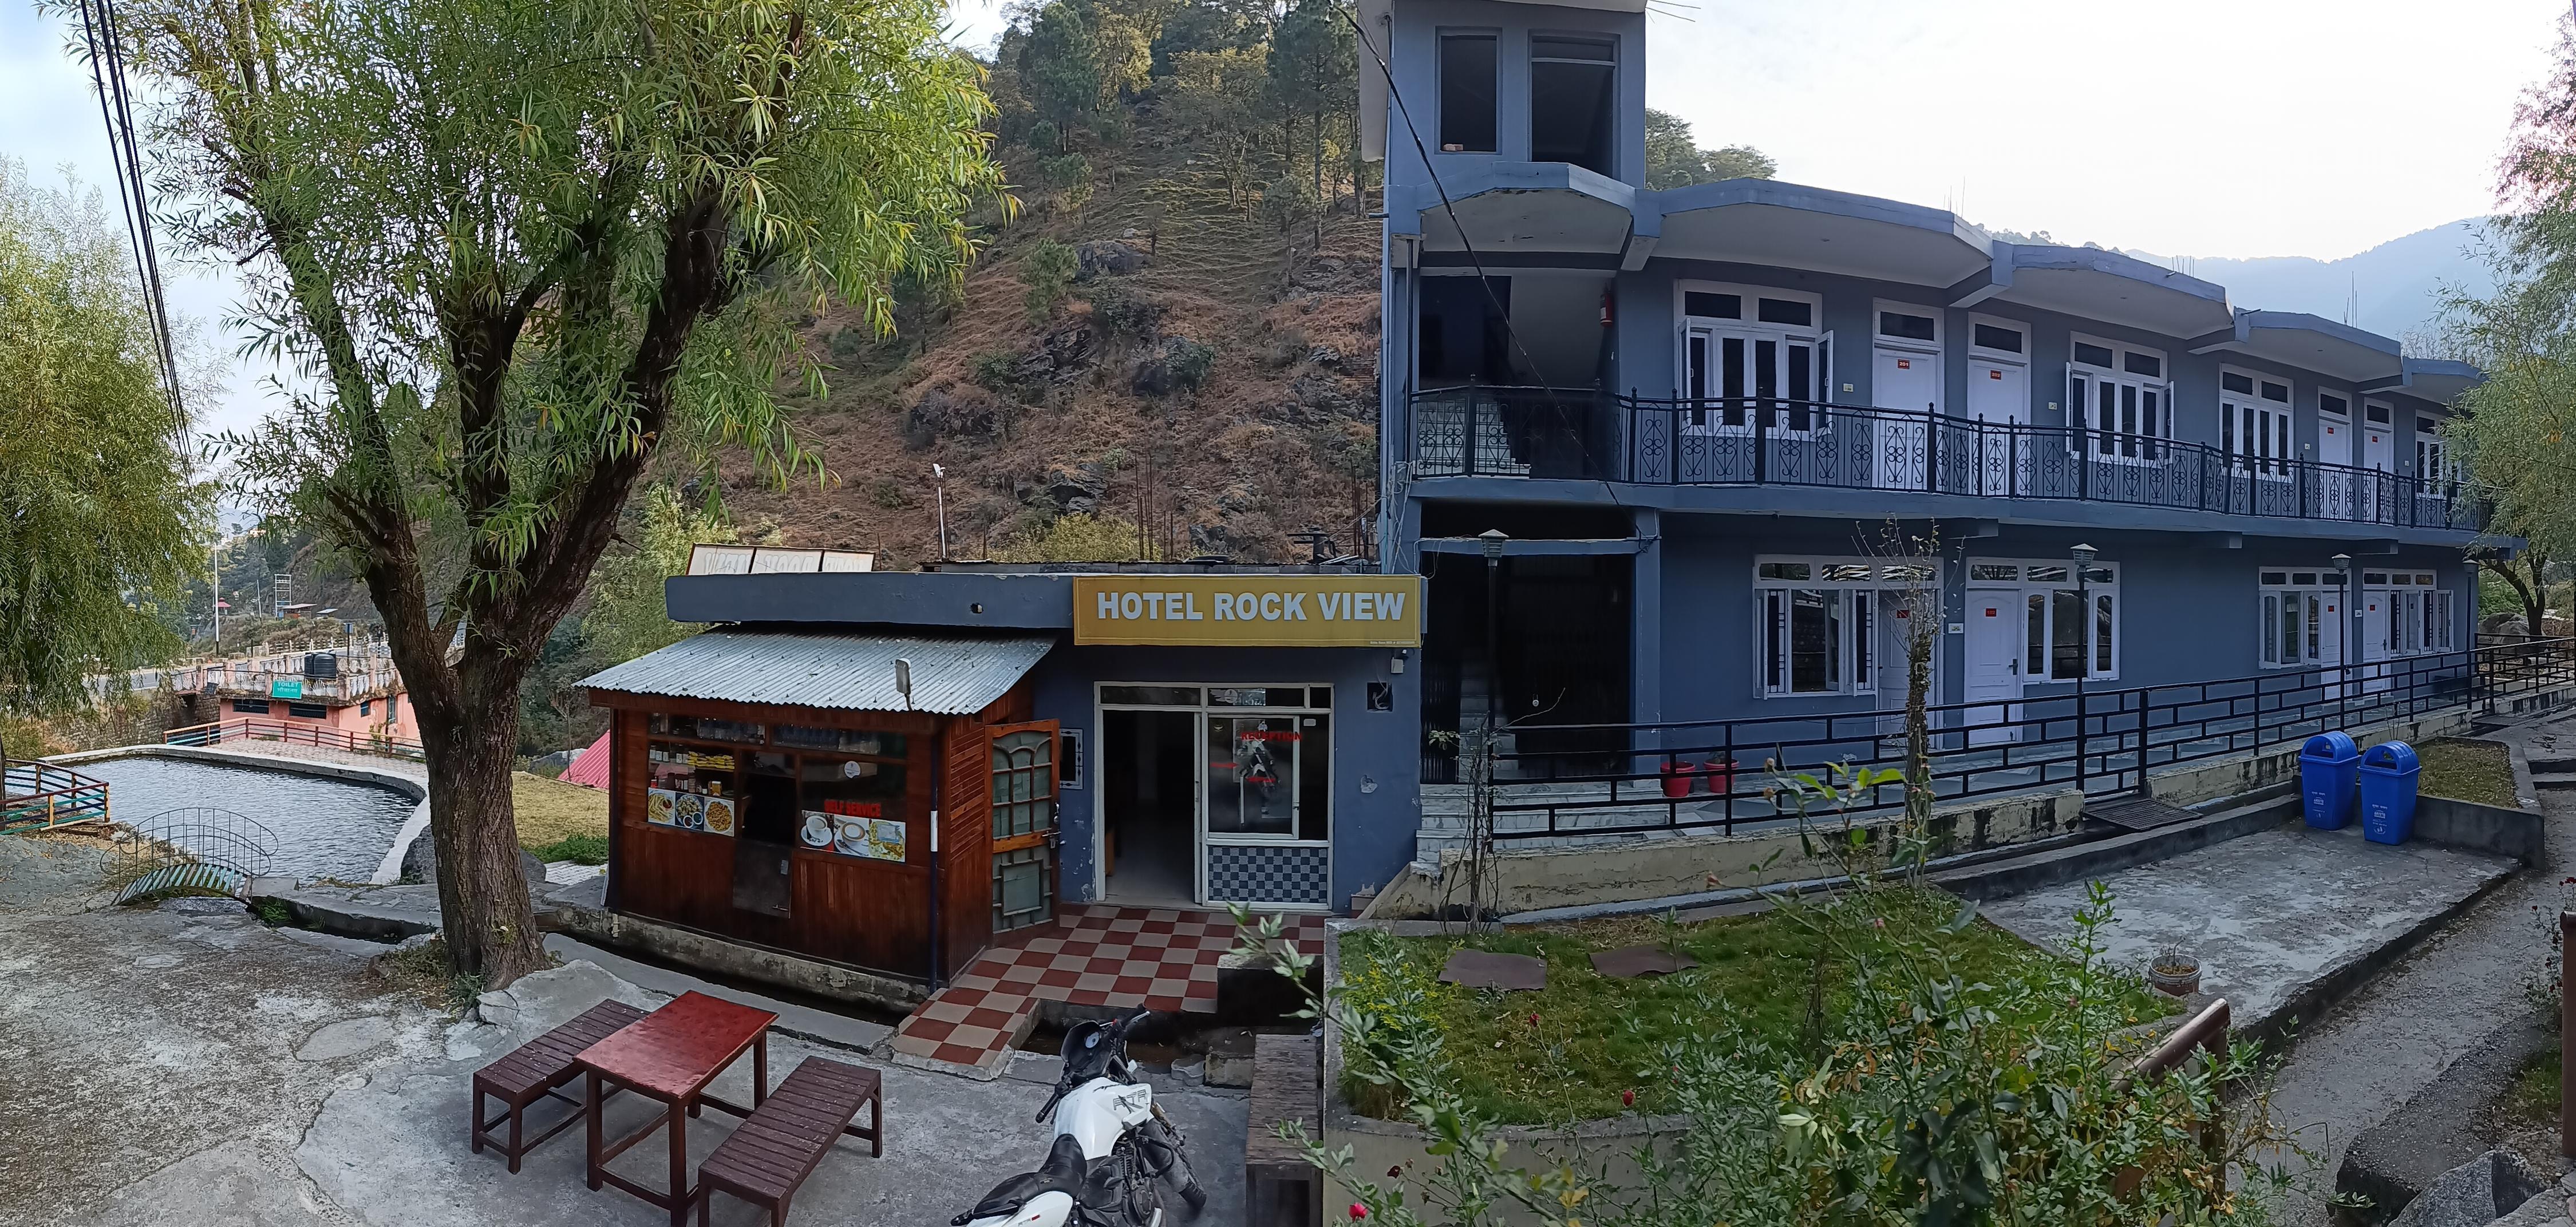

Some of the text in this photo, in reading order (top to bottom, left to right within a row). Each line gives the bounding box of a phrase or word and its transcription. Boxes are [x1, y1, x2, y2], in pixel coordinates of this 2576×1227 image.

[1097, 592, 1406, 620] HOTEL ROCK VIEW
[1240, 731, 1302, 742] RECEPTION
[824, 799, 882, 818] SELF SERVICE
